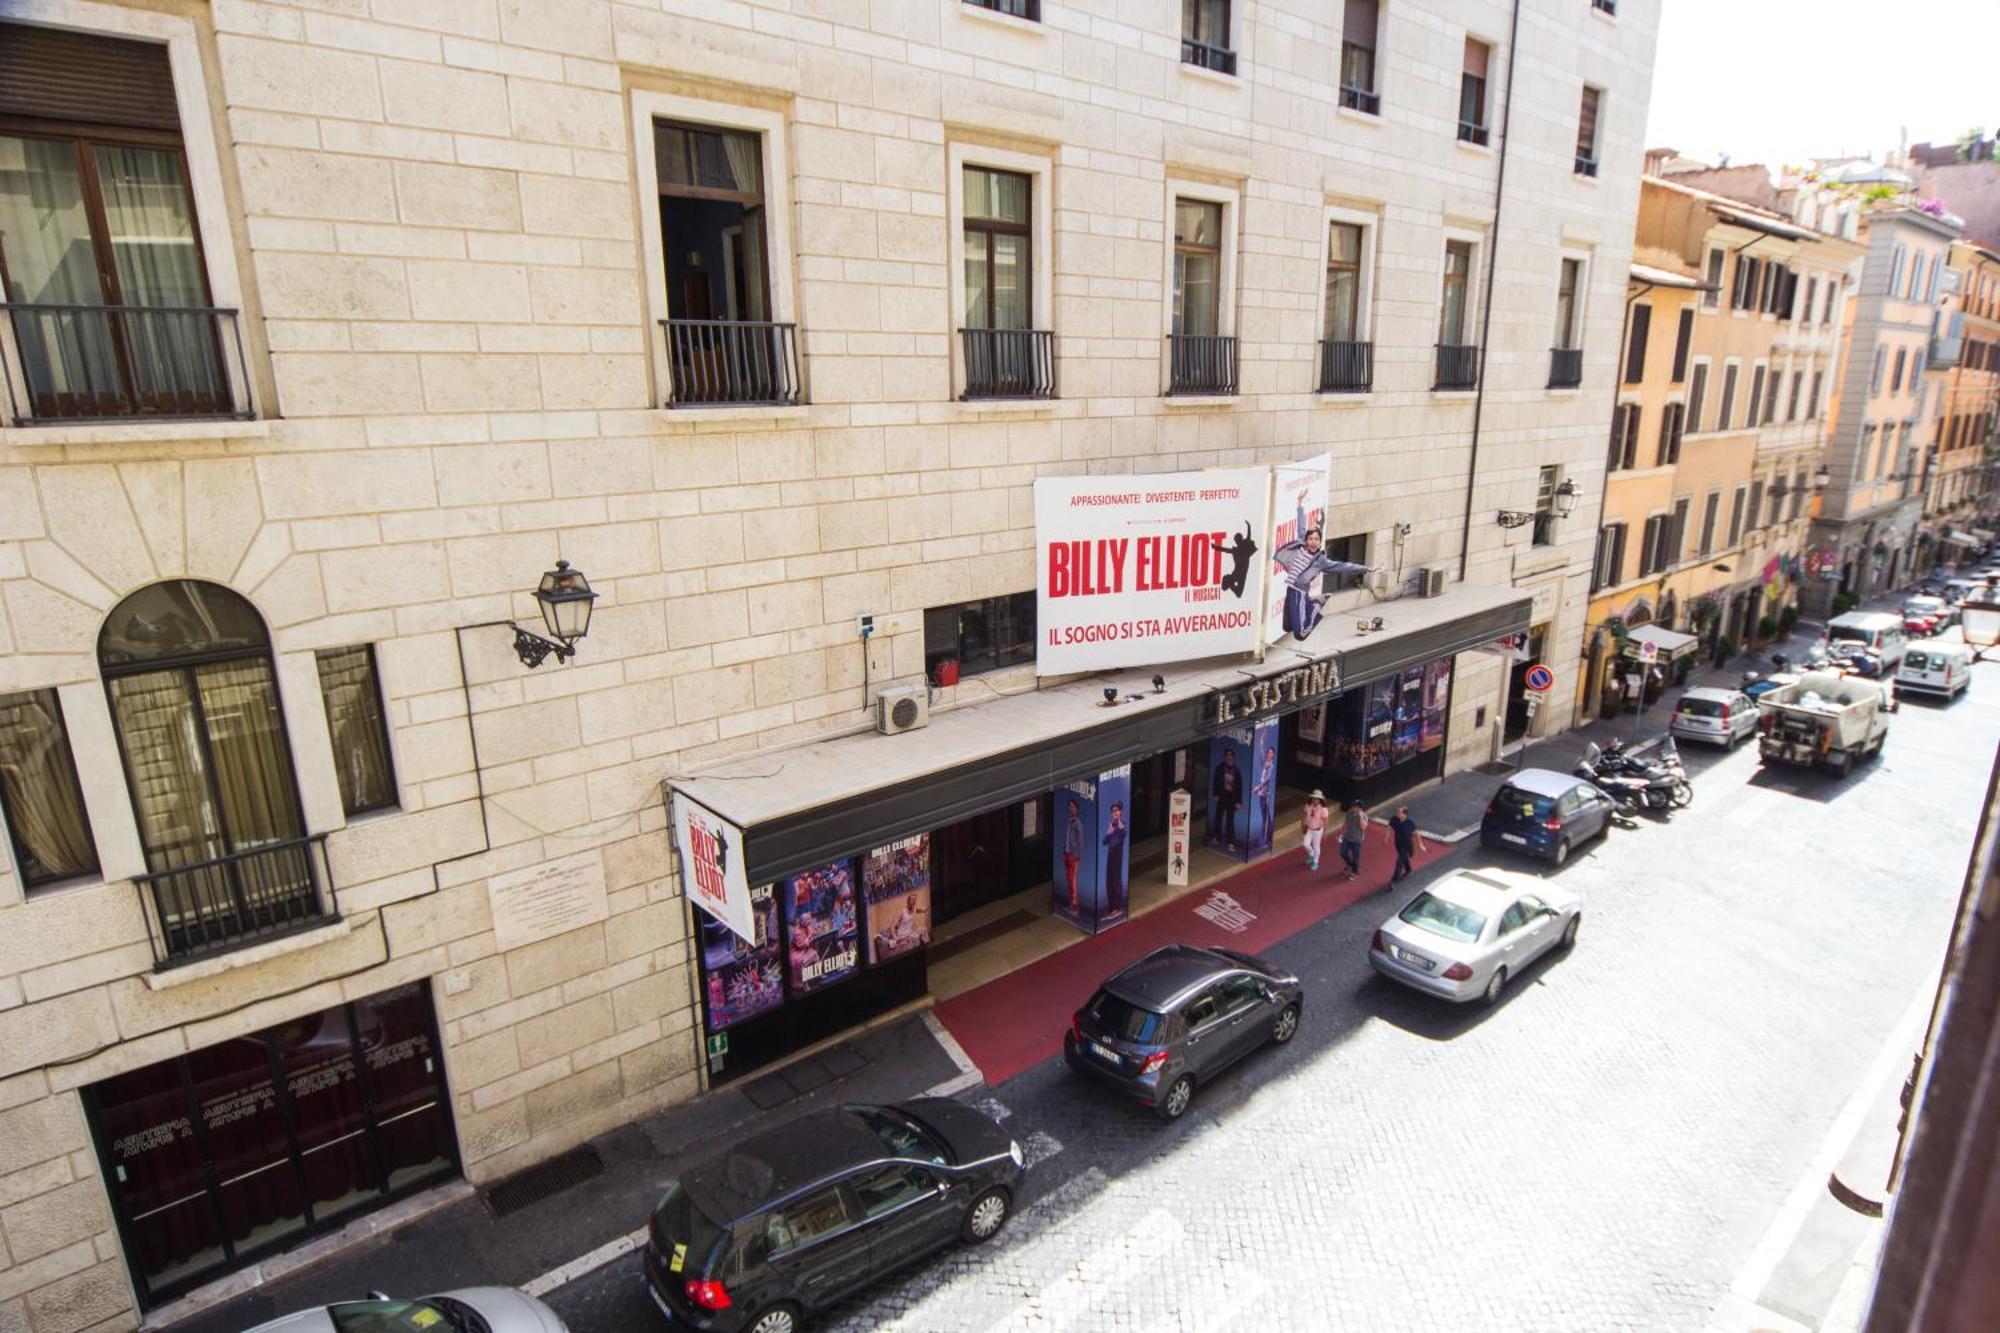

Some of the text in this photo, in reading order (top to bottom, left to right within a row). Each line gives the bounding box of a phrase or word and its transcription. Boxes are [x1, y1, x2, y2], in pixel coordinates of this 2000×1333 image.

[1070, 488, 1240, 507] APPASSIONANTE! DIVERTENTE! PERFETTO!
[1049, 531, 1227, 598] BILLY ELLIOT
[1049, 610, 1252, 646] IL SOGNO SI STA AVVERANDO!
[1217, 659, 1340, 723] IL SISTINA
[689, 825, 716, 866] BILLY
[693, 856, 727, 904] ELLIOT
[802, 951, 848, 982] BILLY ELLIOT
